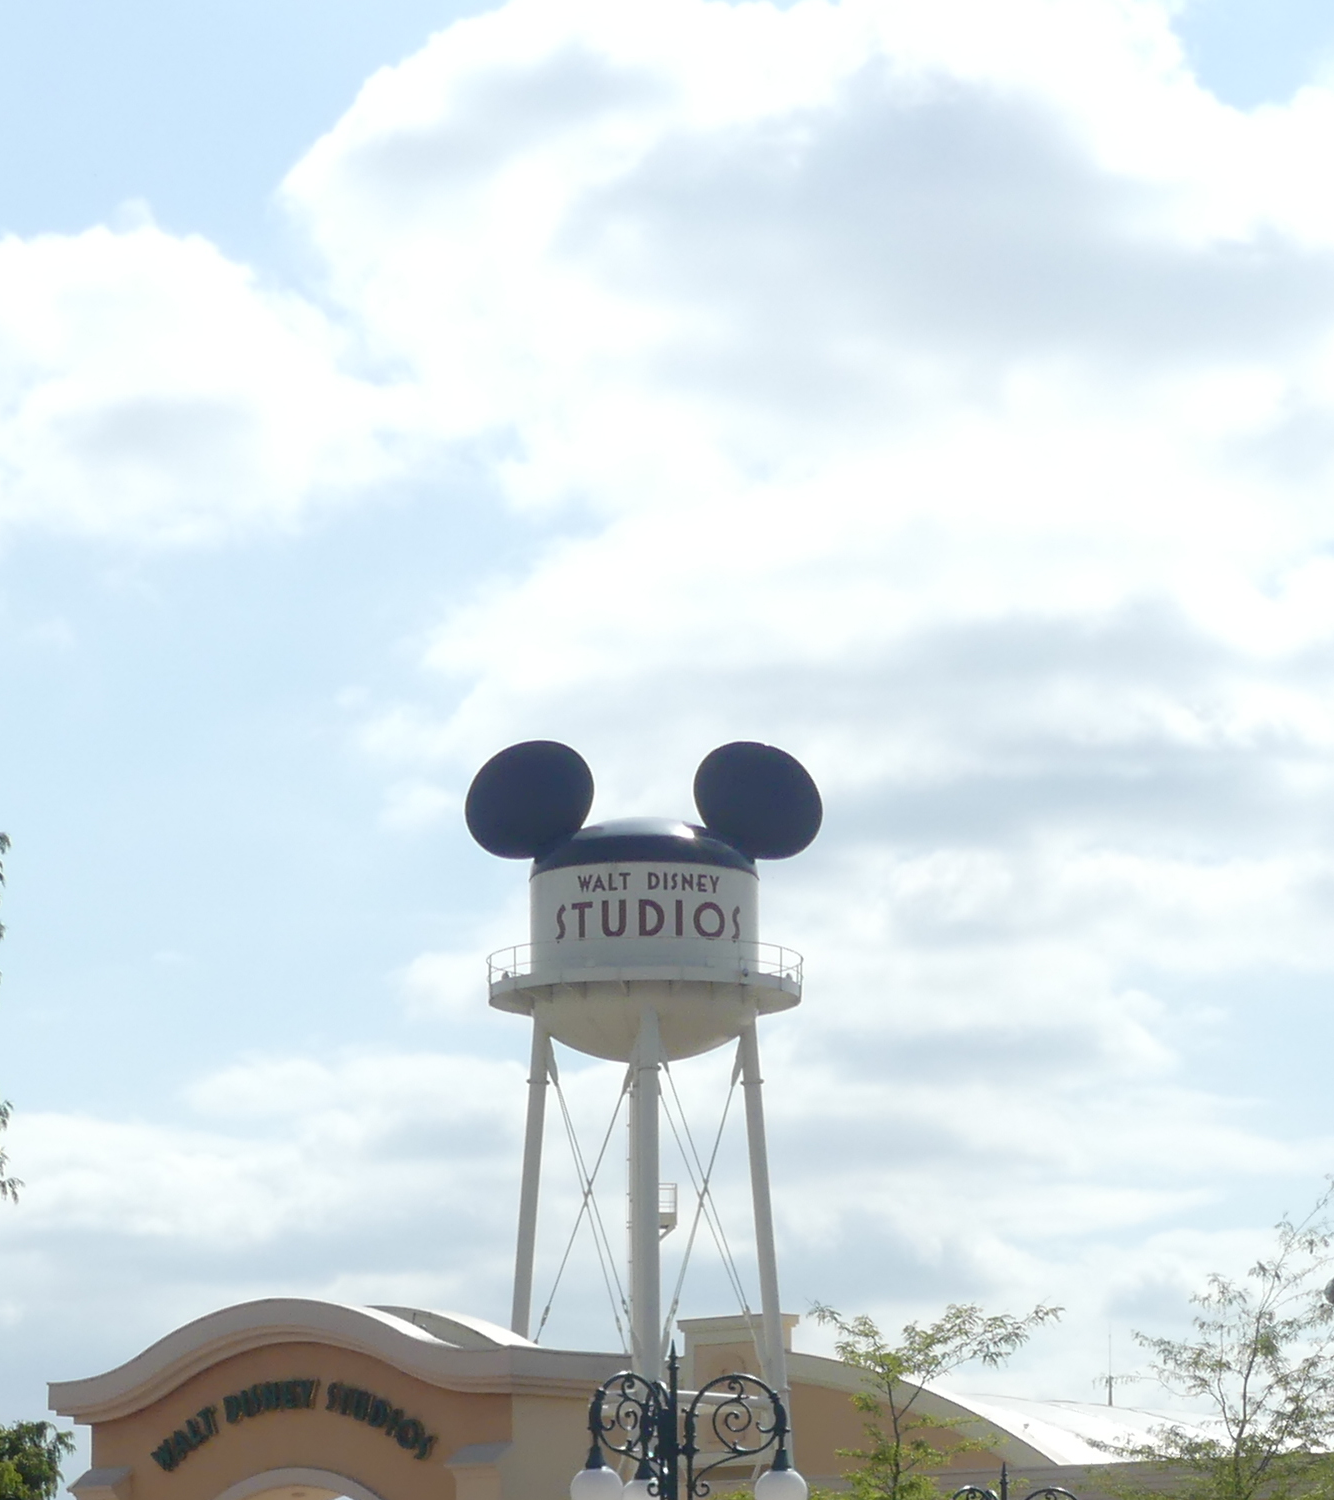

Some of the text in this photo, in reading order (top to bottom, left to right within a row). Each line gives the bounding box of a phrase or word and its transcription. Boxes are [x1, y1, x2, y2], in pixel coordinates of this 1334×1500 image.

[577, 871, 720, 895] WALT DISNEY
[555, 898, 741, 942] STUDIOS
[150, 1378, 438, 1472] WALT DISNEY STUDIOS
